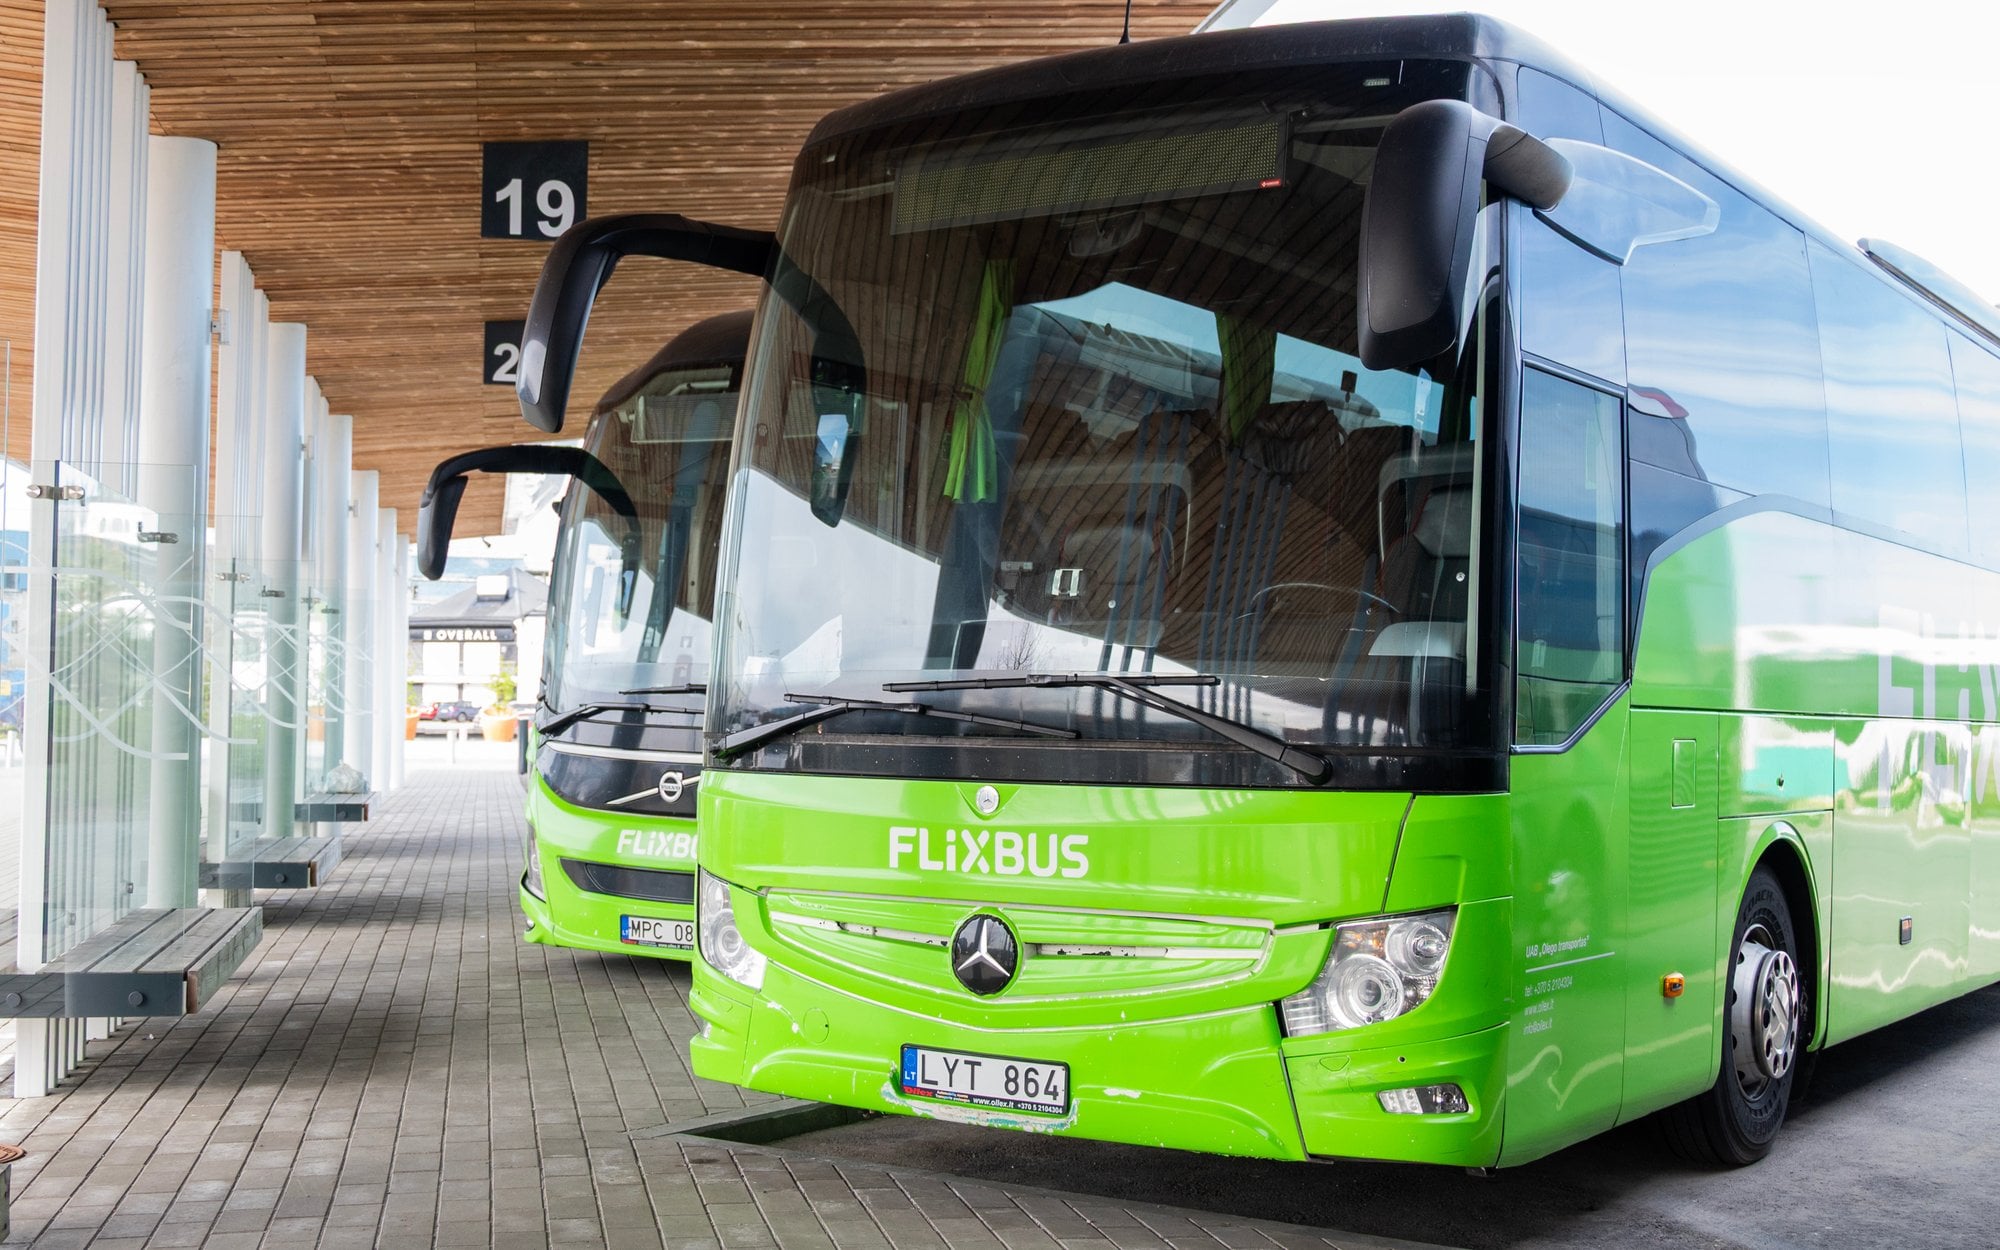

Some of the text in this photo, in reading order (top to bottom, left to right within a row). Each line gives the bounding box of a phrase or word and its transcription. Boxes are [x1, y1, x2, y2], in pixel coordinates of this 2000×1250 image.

[496, 178, 575, 237] 19
[492, 342, 520, 382] 2
[436, 629, 497, 640] OVERALL
[889, 826, 1089, 878] FLiXBUS
[631, 919, 663, 940] MPC
[674, 923, 694, 942] 08
[1525, 944, 1539, 958] UAB
[904, 1071, 916, 1081] LT
[921, 1053, 982, 1091] LYT
[1004, 1065, 1059, 1100] 864
[1017, 1102, 1032, 1110] +370
